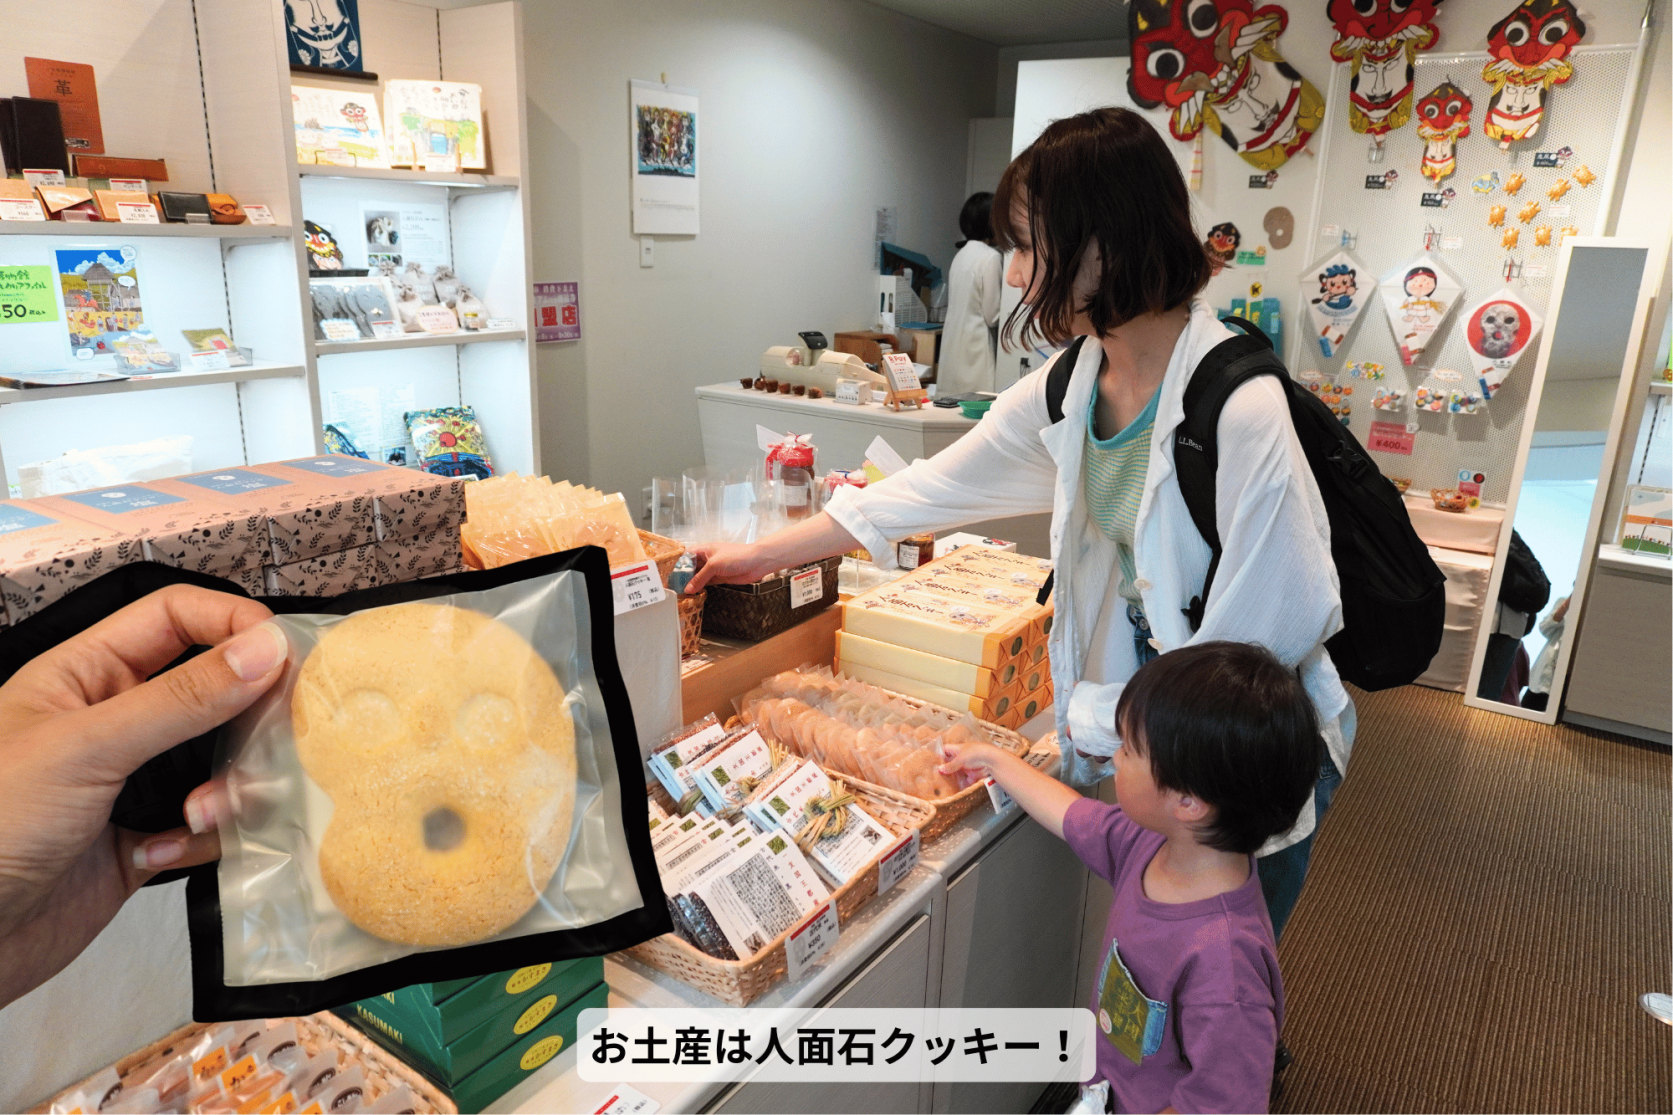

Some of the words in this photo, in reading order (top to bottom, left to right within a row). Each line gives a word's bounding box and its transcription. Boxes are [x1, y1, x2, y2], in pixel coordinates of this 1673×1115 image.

[54, 79, 73, 96] 革
[534, 304, 578, 327] 盟店
[357, 1004, 403, 1044] KASUMAKI
